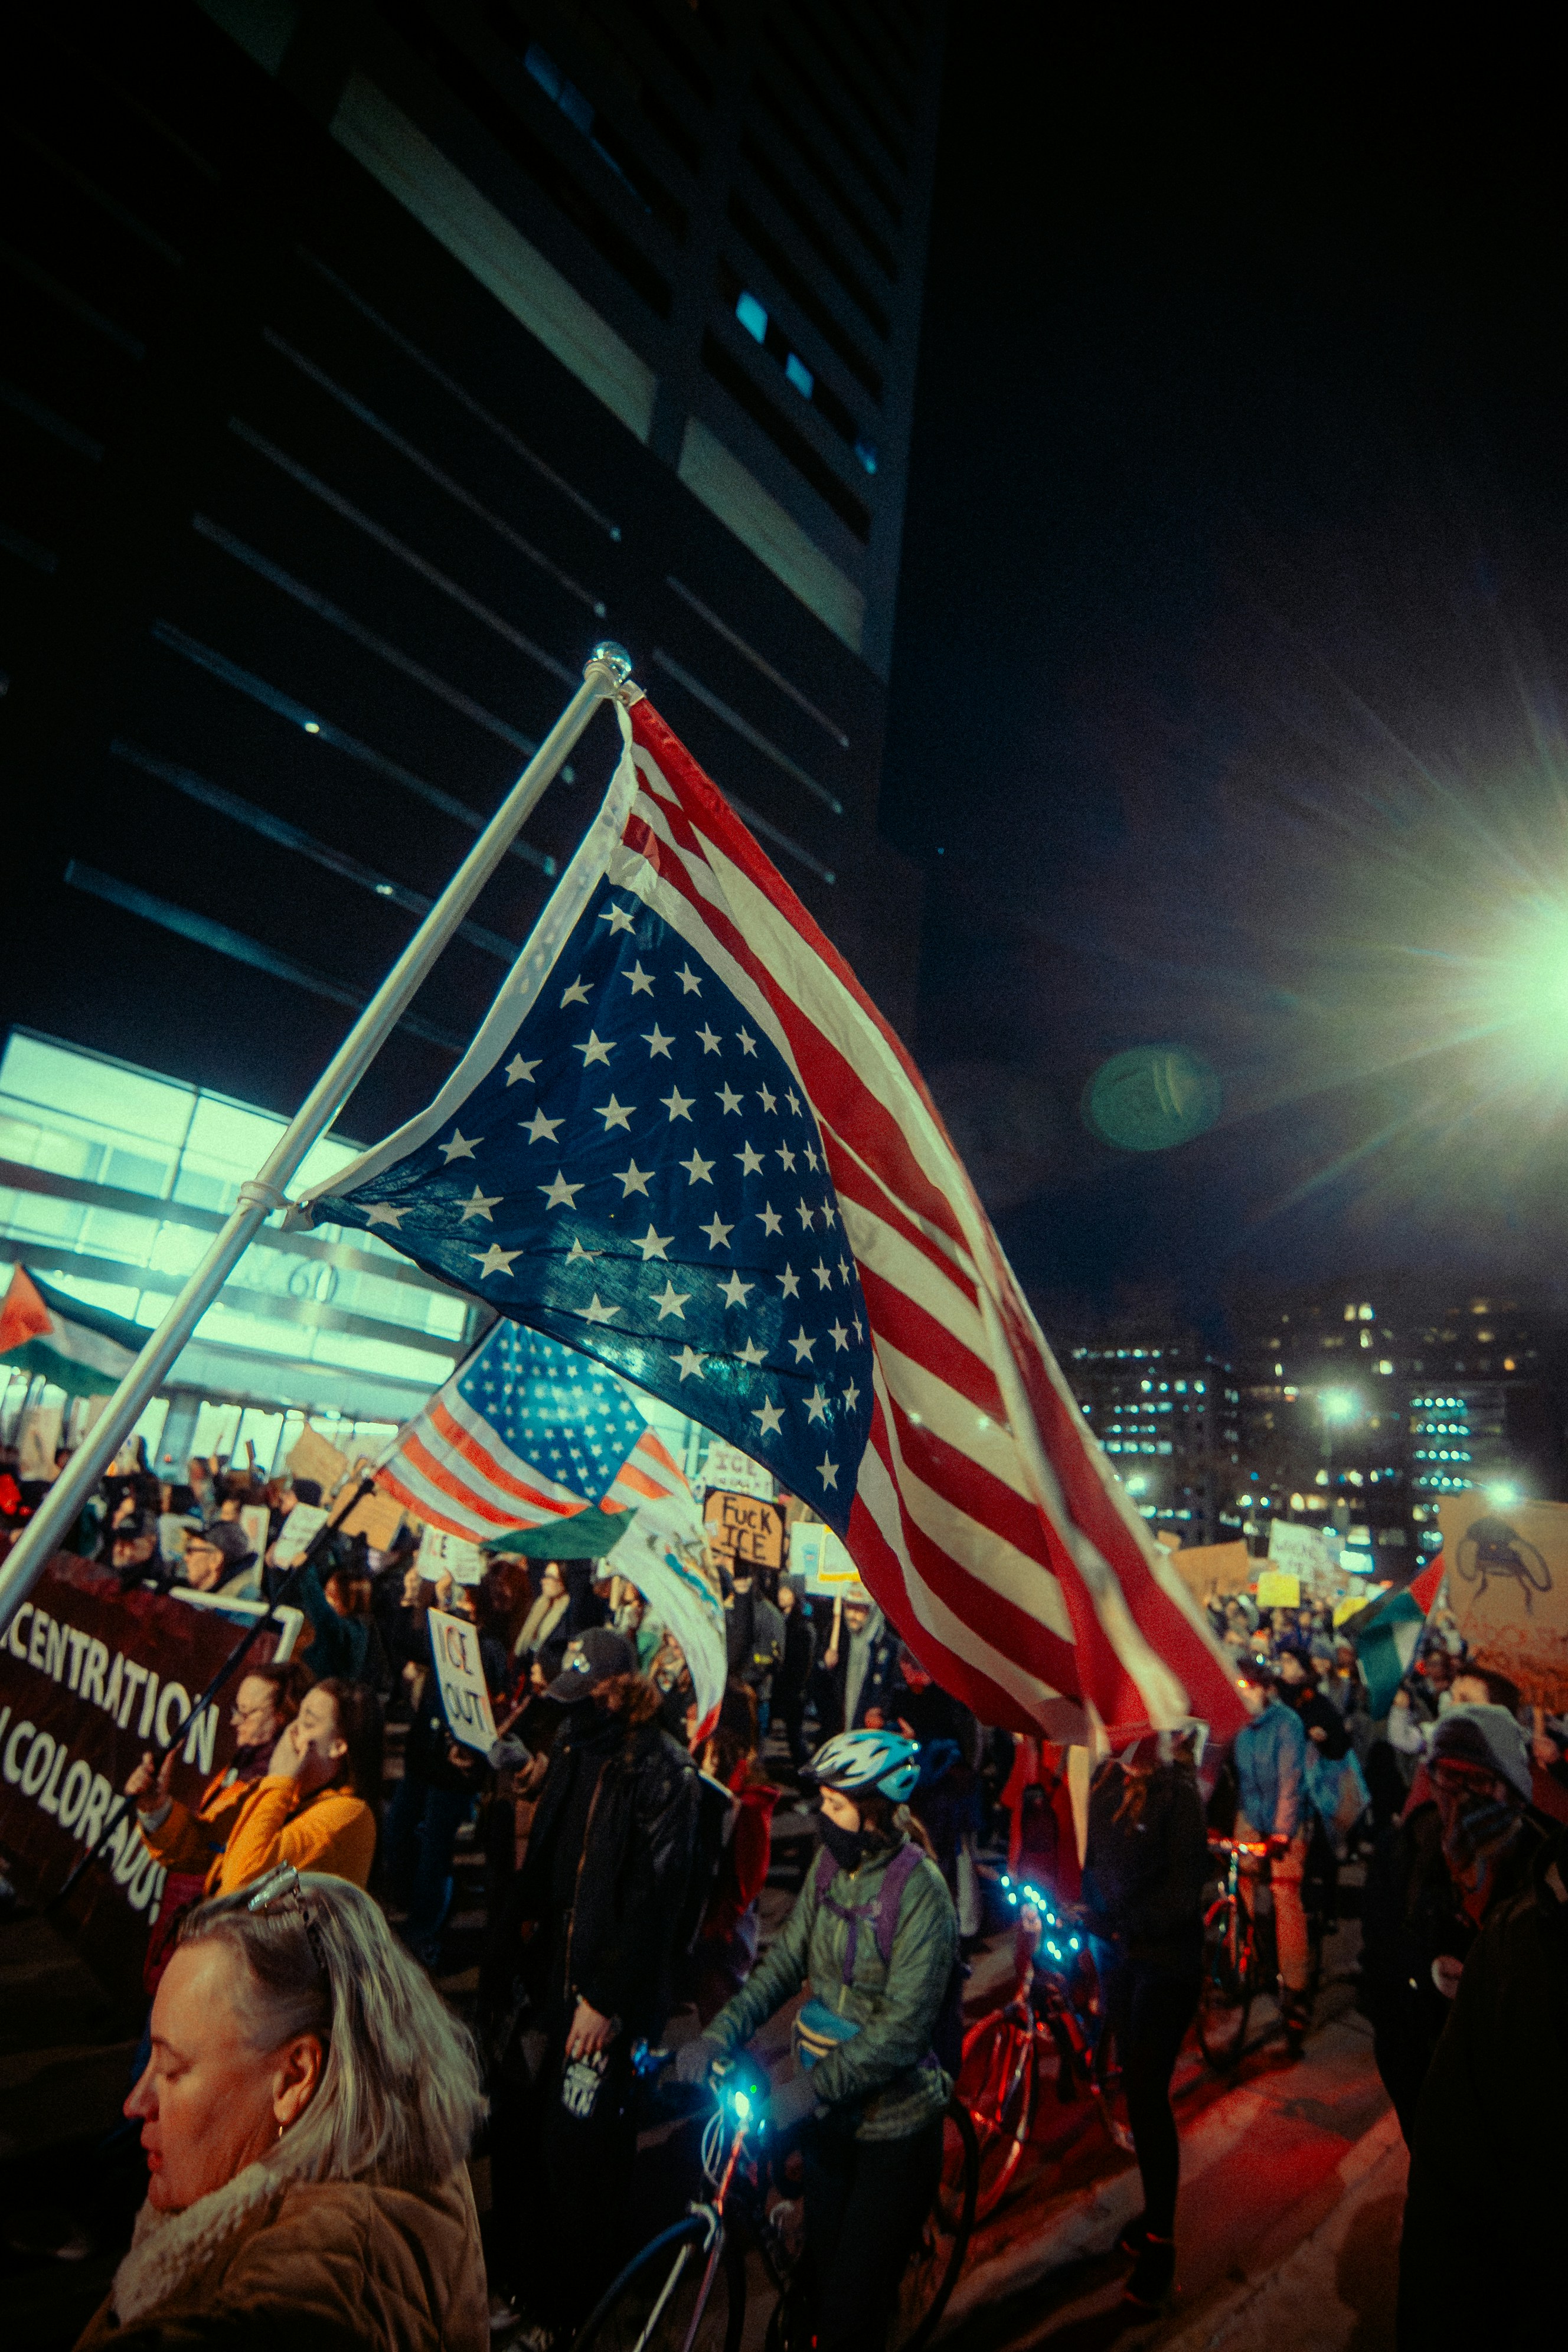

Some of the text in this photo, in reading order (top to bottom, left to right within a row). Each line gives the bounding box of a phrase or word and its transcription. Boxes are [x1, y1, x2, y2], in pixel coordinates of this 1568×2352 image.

[288, 1259, 339, 1304] 60
[721, 1525, 766, 1560] ICE
[0, 1601, 220, 1775] CENTRATION
